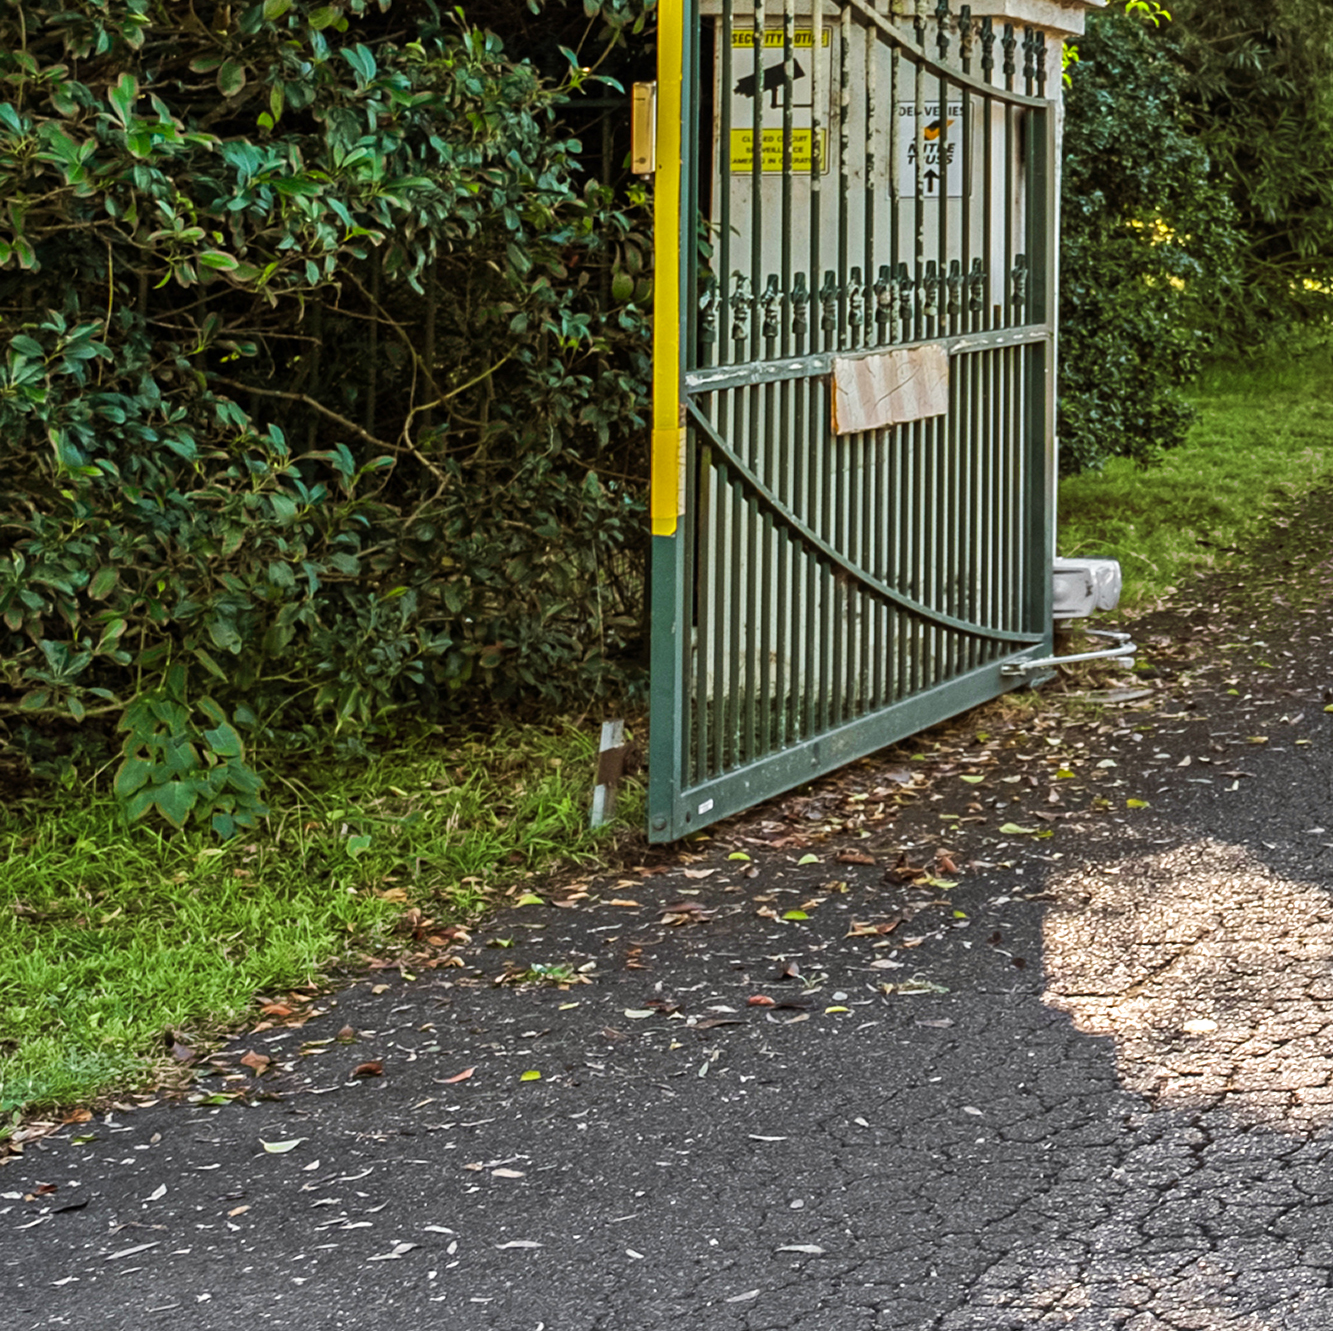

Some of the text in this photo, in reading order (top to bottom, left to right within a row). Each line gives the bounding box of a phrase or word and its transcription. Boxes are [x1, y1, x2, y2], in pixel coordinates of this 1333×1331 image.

[731, 33, 826, 44] SECITY OTI
[898, 106, 963, 117] DEVEIES
[741, 135, 808, 143] CLED CUIT
[907, 142, 956, 154] MITE
[907, 154, 954, 165] TUS
